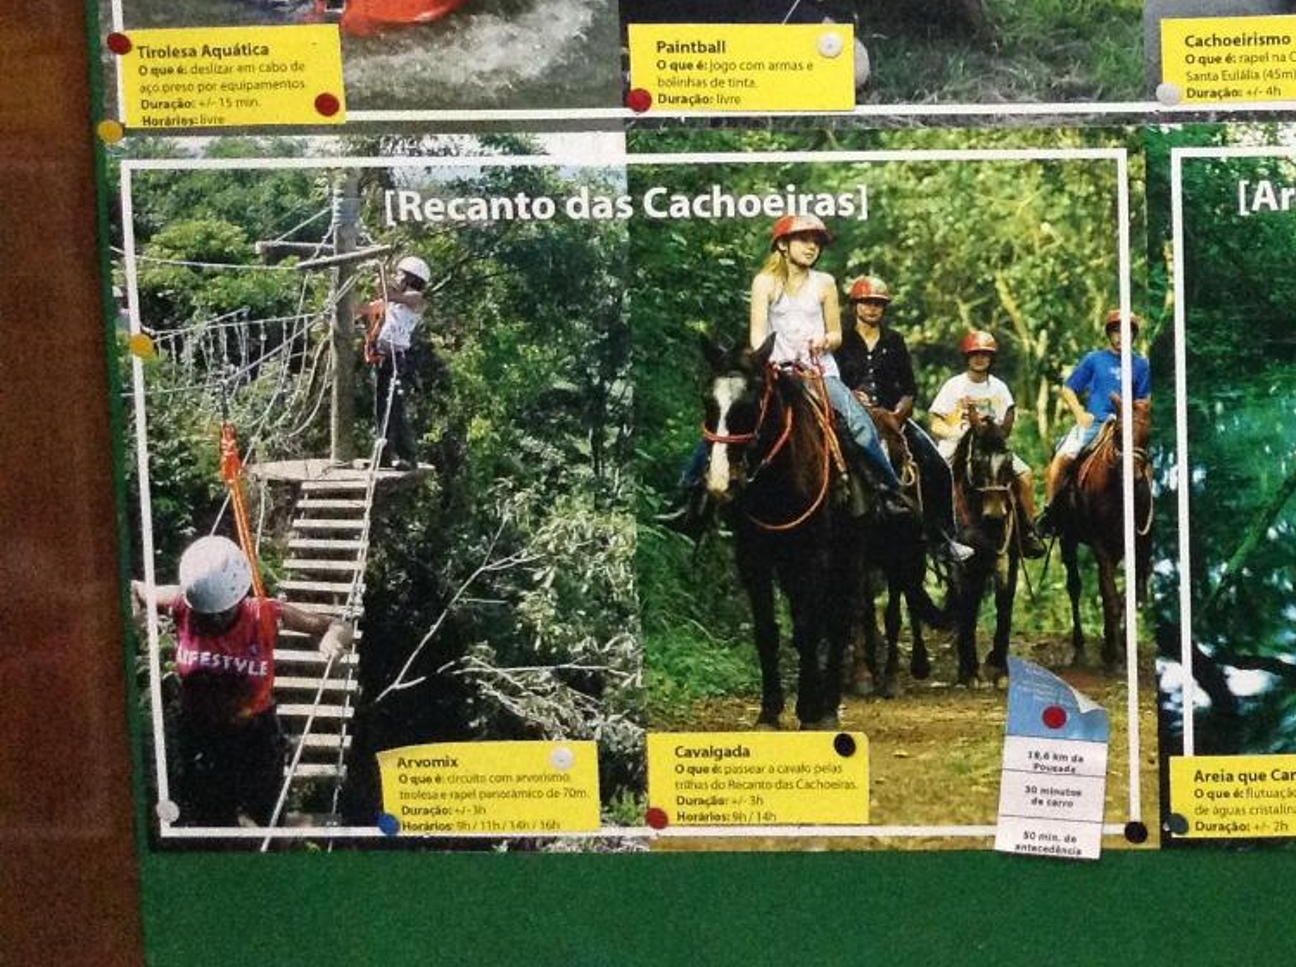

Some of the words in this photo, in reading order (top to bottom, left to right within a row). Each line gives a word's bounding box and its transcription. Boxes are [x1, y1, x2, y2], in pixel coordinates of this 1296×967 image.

[1185, 32, 1291, 48] Cachoeirismo
[137, 45, 198, 59] Tirolesa
[201, 42, 269, 58] Aquática
[656, 40, 726, 54] Paintball
[1185, 54, 1195, 65] O
[1198, 54, 1222, 66] que
[1239, 52, 1269, 64] rapel
[1272, 54, 1286, 62] na
[138, 66, 148, 76] O
[151, 66, 175, 78] que
[191, 63, 233, 74] deslizar
[236, 65, 255, 73] em
[259, 62, 287, 73] cabo
[290, 61, 305, 72] de
[657, 61, 666, 70] O
[669, 62, 694, 72] que
[710, 61, 736, 73] jogo
[739, 62, 765, 71] com
[769, 62, 803, 71] armas
[1186, 70, 1219, 82] Santa
[220, 80, 305, 91] equipamentos
[710, 77, 726, 88] de
[1186, 87, 1243, 100] Duração:
[141, 99, 195, 110] Duração:
[658, 94, 713, 107] Duração:
[716, 94, 741, 104] livre
[386, 188, 556, 228] [Recanto
[565, 186, 633, 220] das
[642, 183, 869, 221] Cachoeiras]
[675, 745, 750, 761] Cavalgada
[397, 756, 458, 768] Arvomix
[675, 764, 685, 774] O
[687, 766, 711, 776] que
[410, 776, 432, 785] que
[488, 774, 512, 783] com
[1194, 770, 1234, 783] Areia
[1238, 770, 1267, 785] que
[728, 780, 772, 790] Recanto
[775, 779, 794, 789] das
[1194, 789, 1204, 799] O
[1207, 790, 1231, 801] que
[677, 796, 728, 808] Duração:
[401, 806, 452, 818] Duração:
[1194, 805, 1209, 815] de
[1195, 821, 1251, 833] Duração:
